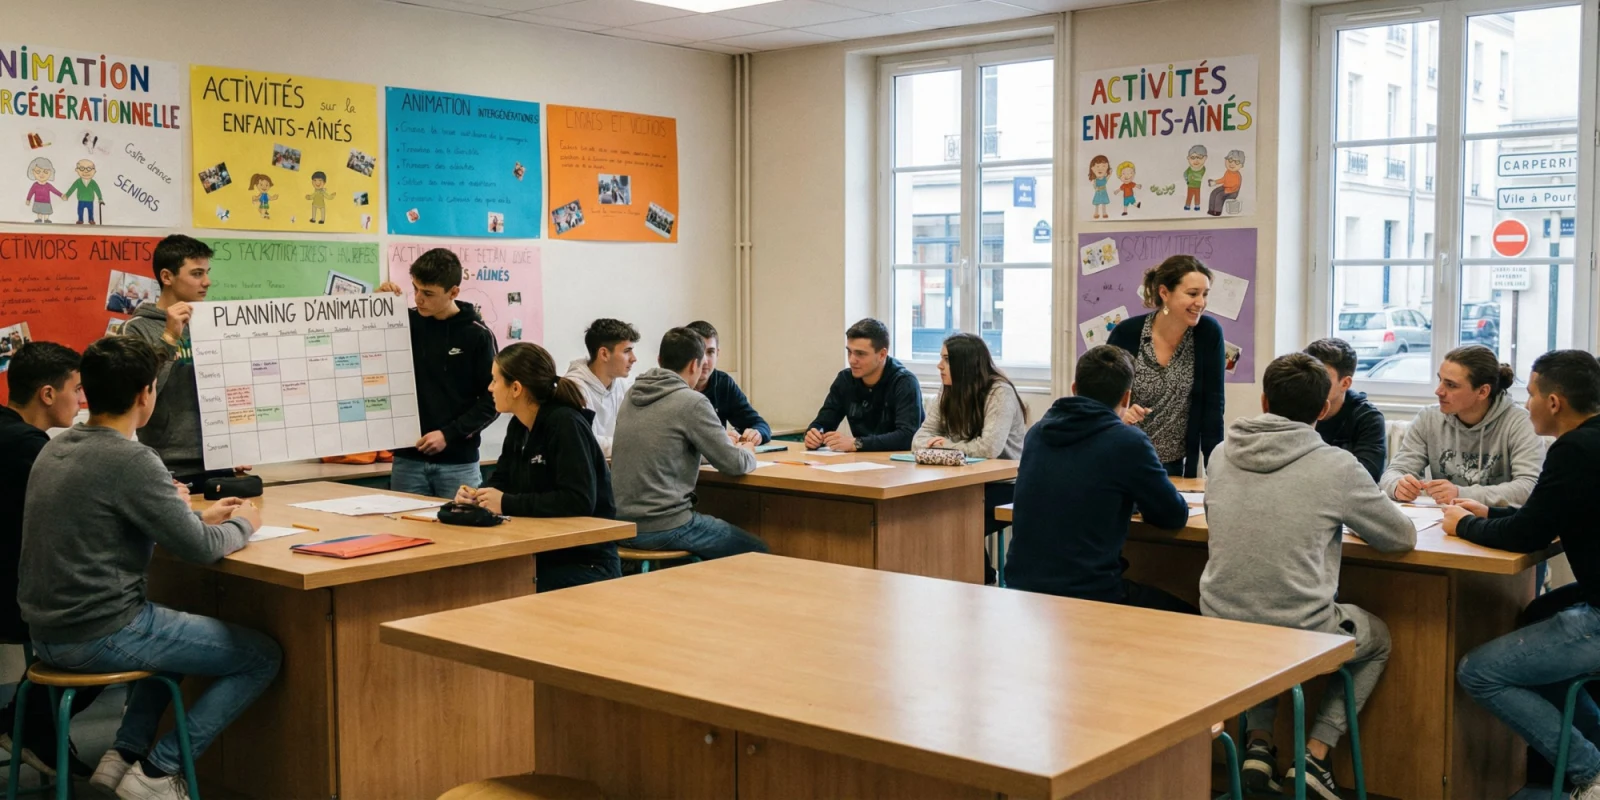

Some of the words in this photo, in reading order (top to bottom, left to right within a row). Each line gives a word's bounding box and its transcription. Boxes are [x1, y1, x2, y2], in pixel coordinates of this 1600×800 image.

[320, 101, 337, 111] sur
[1082, 94, 1252, 142] ENFANTS-AÎNÉS
[223, 113, 352, 143] ENFANTS-AÎNÉS
[113, 174, 160, 212] SENIORS
